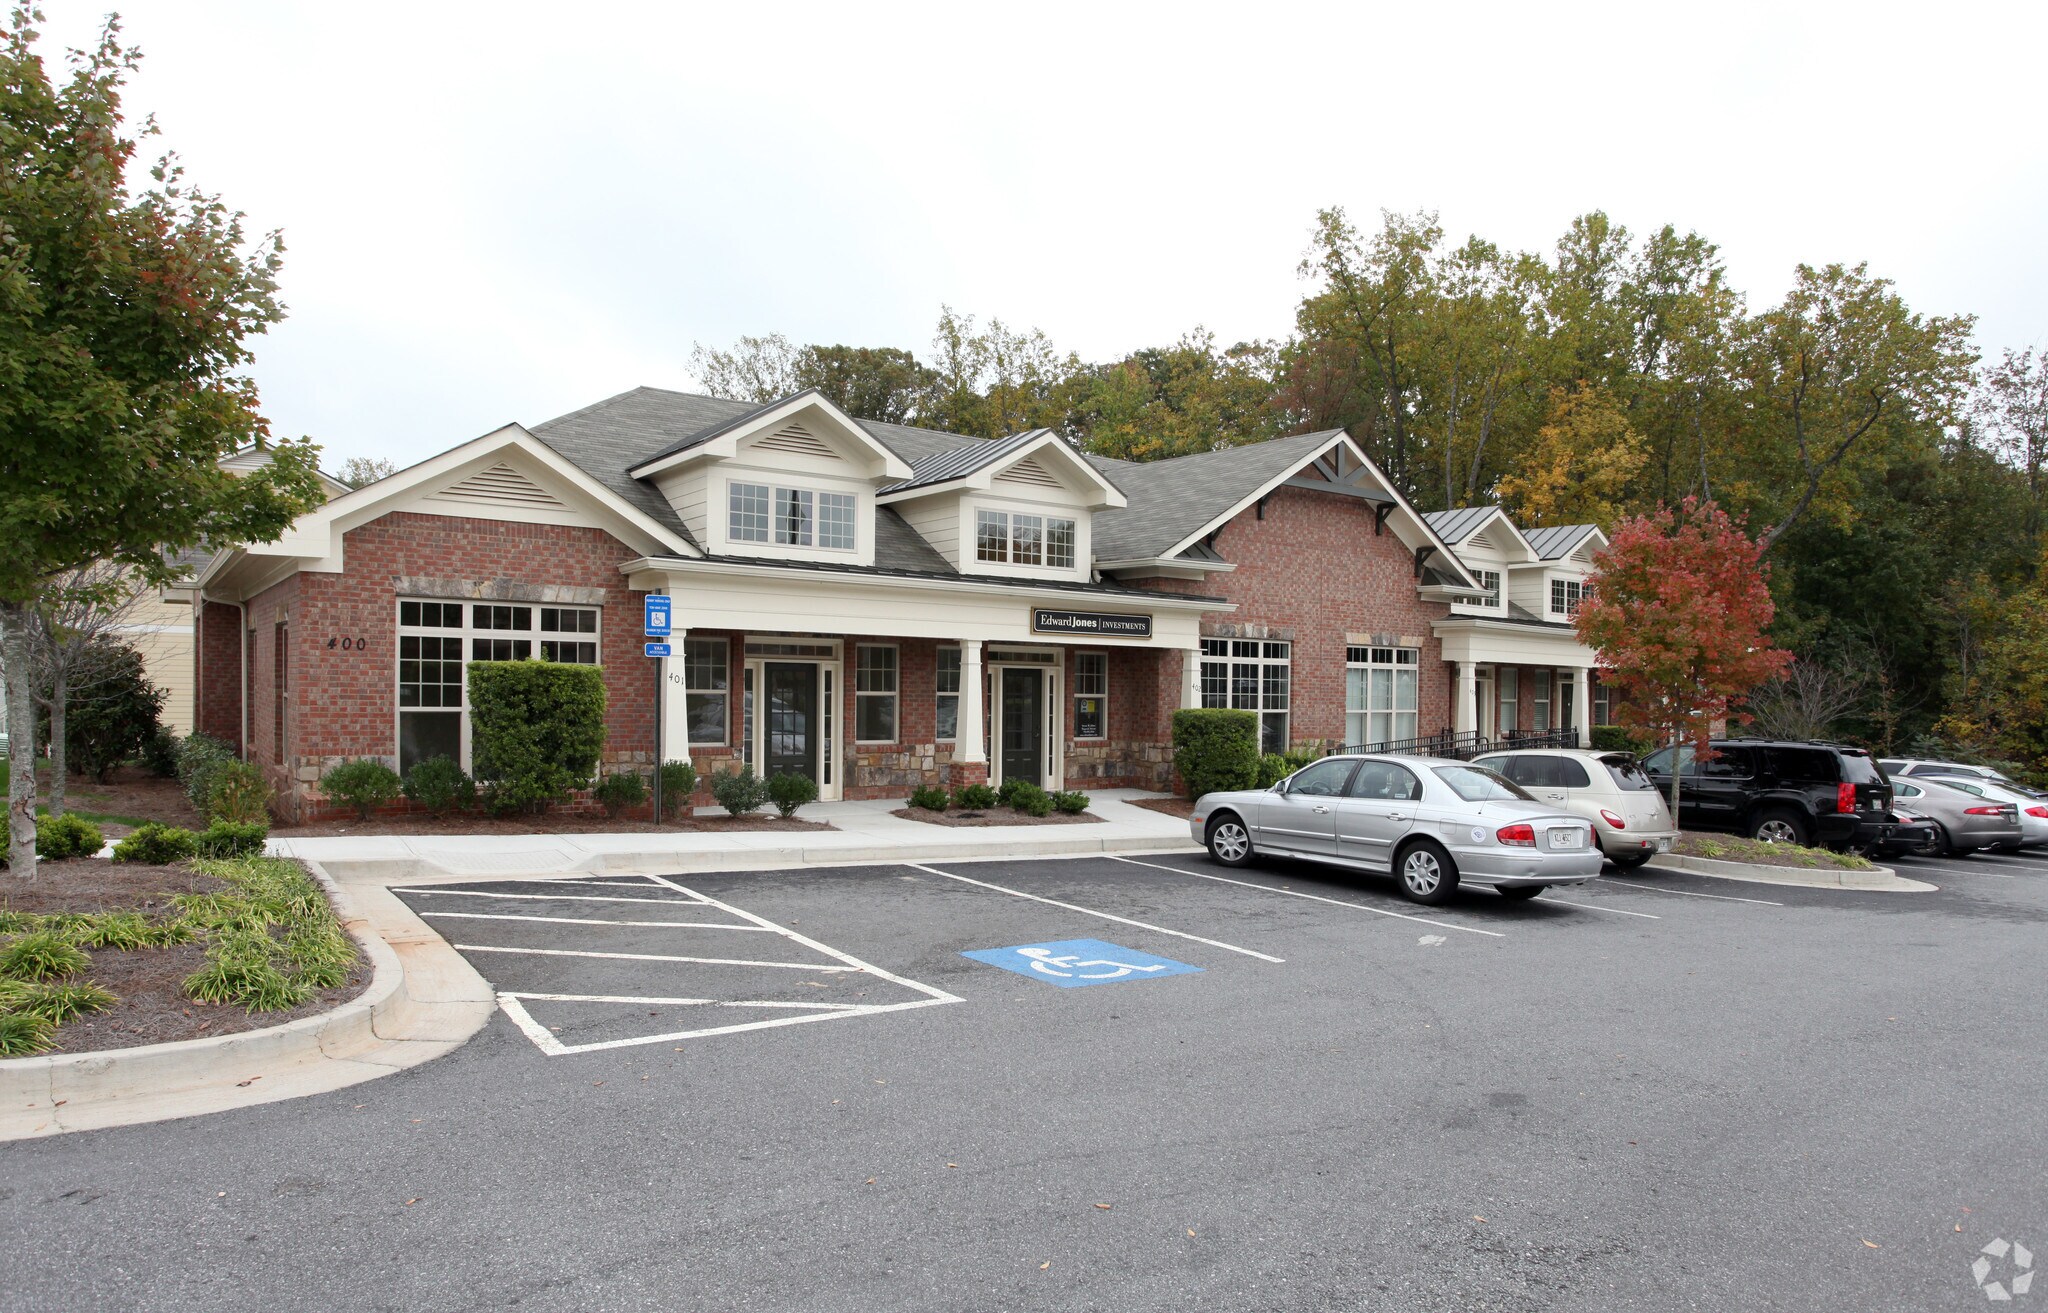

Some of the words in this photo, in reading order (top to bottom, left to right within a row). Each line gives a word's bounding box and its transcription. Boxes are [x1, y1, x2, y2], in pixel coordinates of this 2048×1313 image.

[1102, 621, 1146, 631] INVESTMENTS
[327, 637, 366, 651] 400
[669, 672, 684, 685] 401
